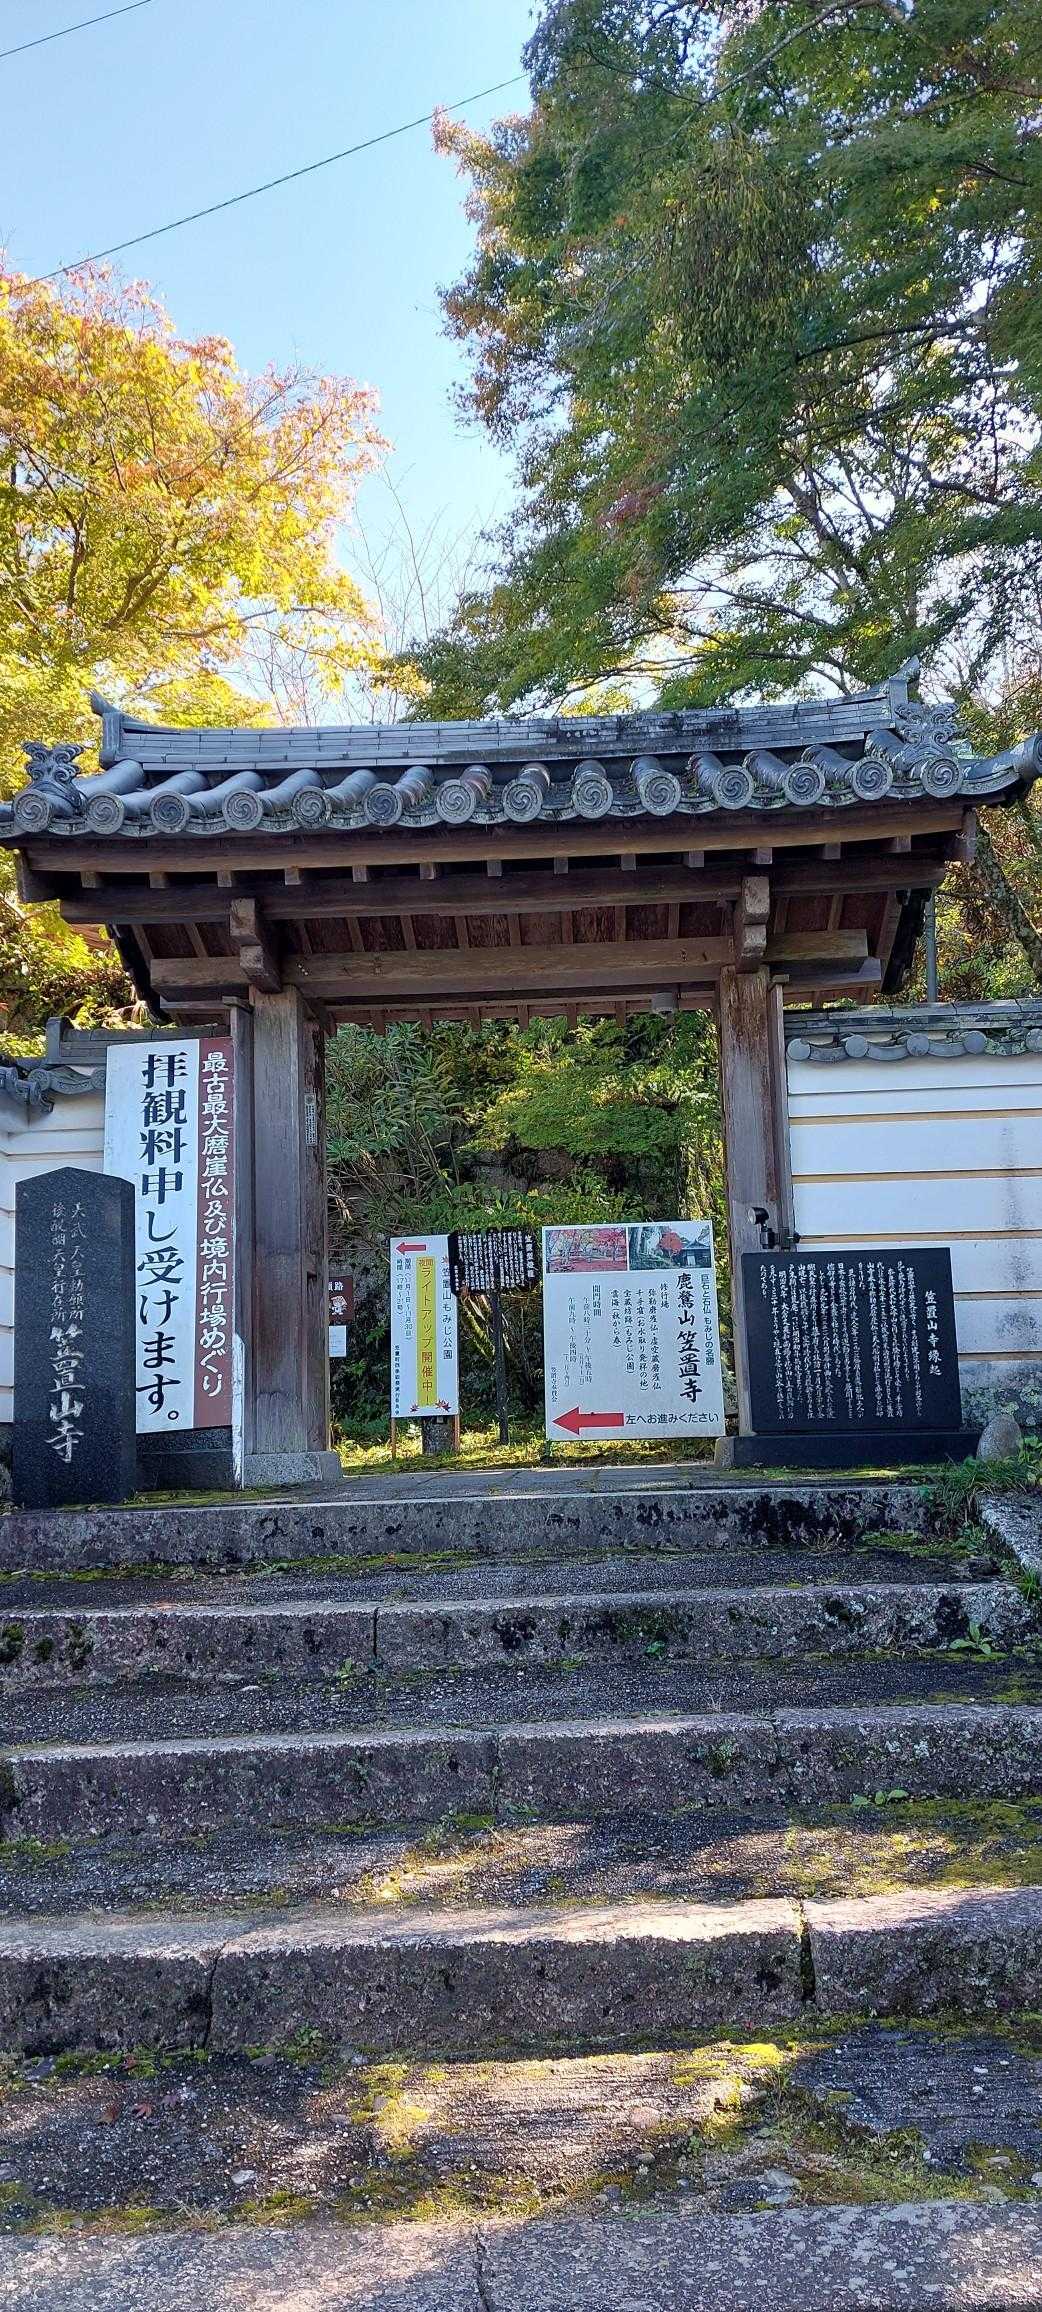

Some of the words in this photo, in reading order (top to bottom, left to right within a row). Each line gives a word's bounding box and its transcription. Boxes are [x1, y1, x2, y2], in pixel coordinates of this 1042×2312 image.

[136, 1051, 189, 1422] 拝観料申し受けます。
[200, 1051, 230, 1398] 最古最大磨崖仏及び境内行場めぐり
[45, 1323, 86, 1464] 笠置山寺
[626, 1413, 719, 1425] 左へお進みください
[677, 1330, 702, 1403] 笠置寺
